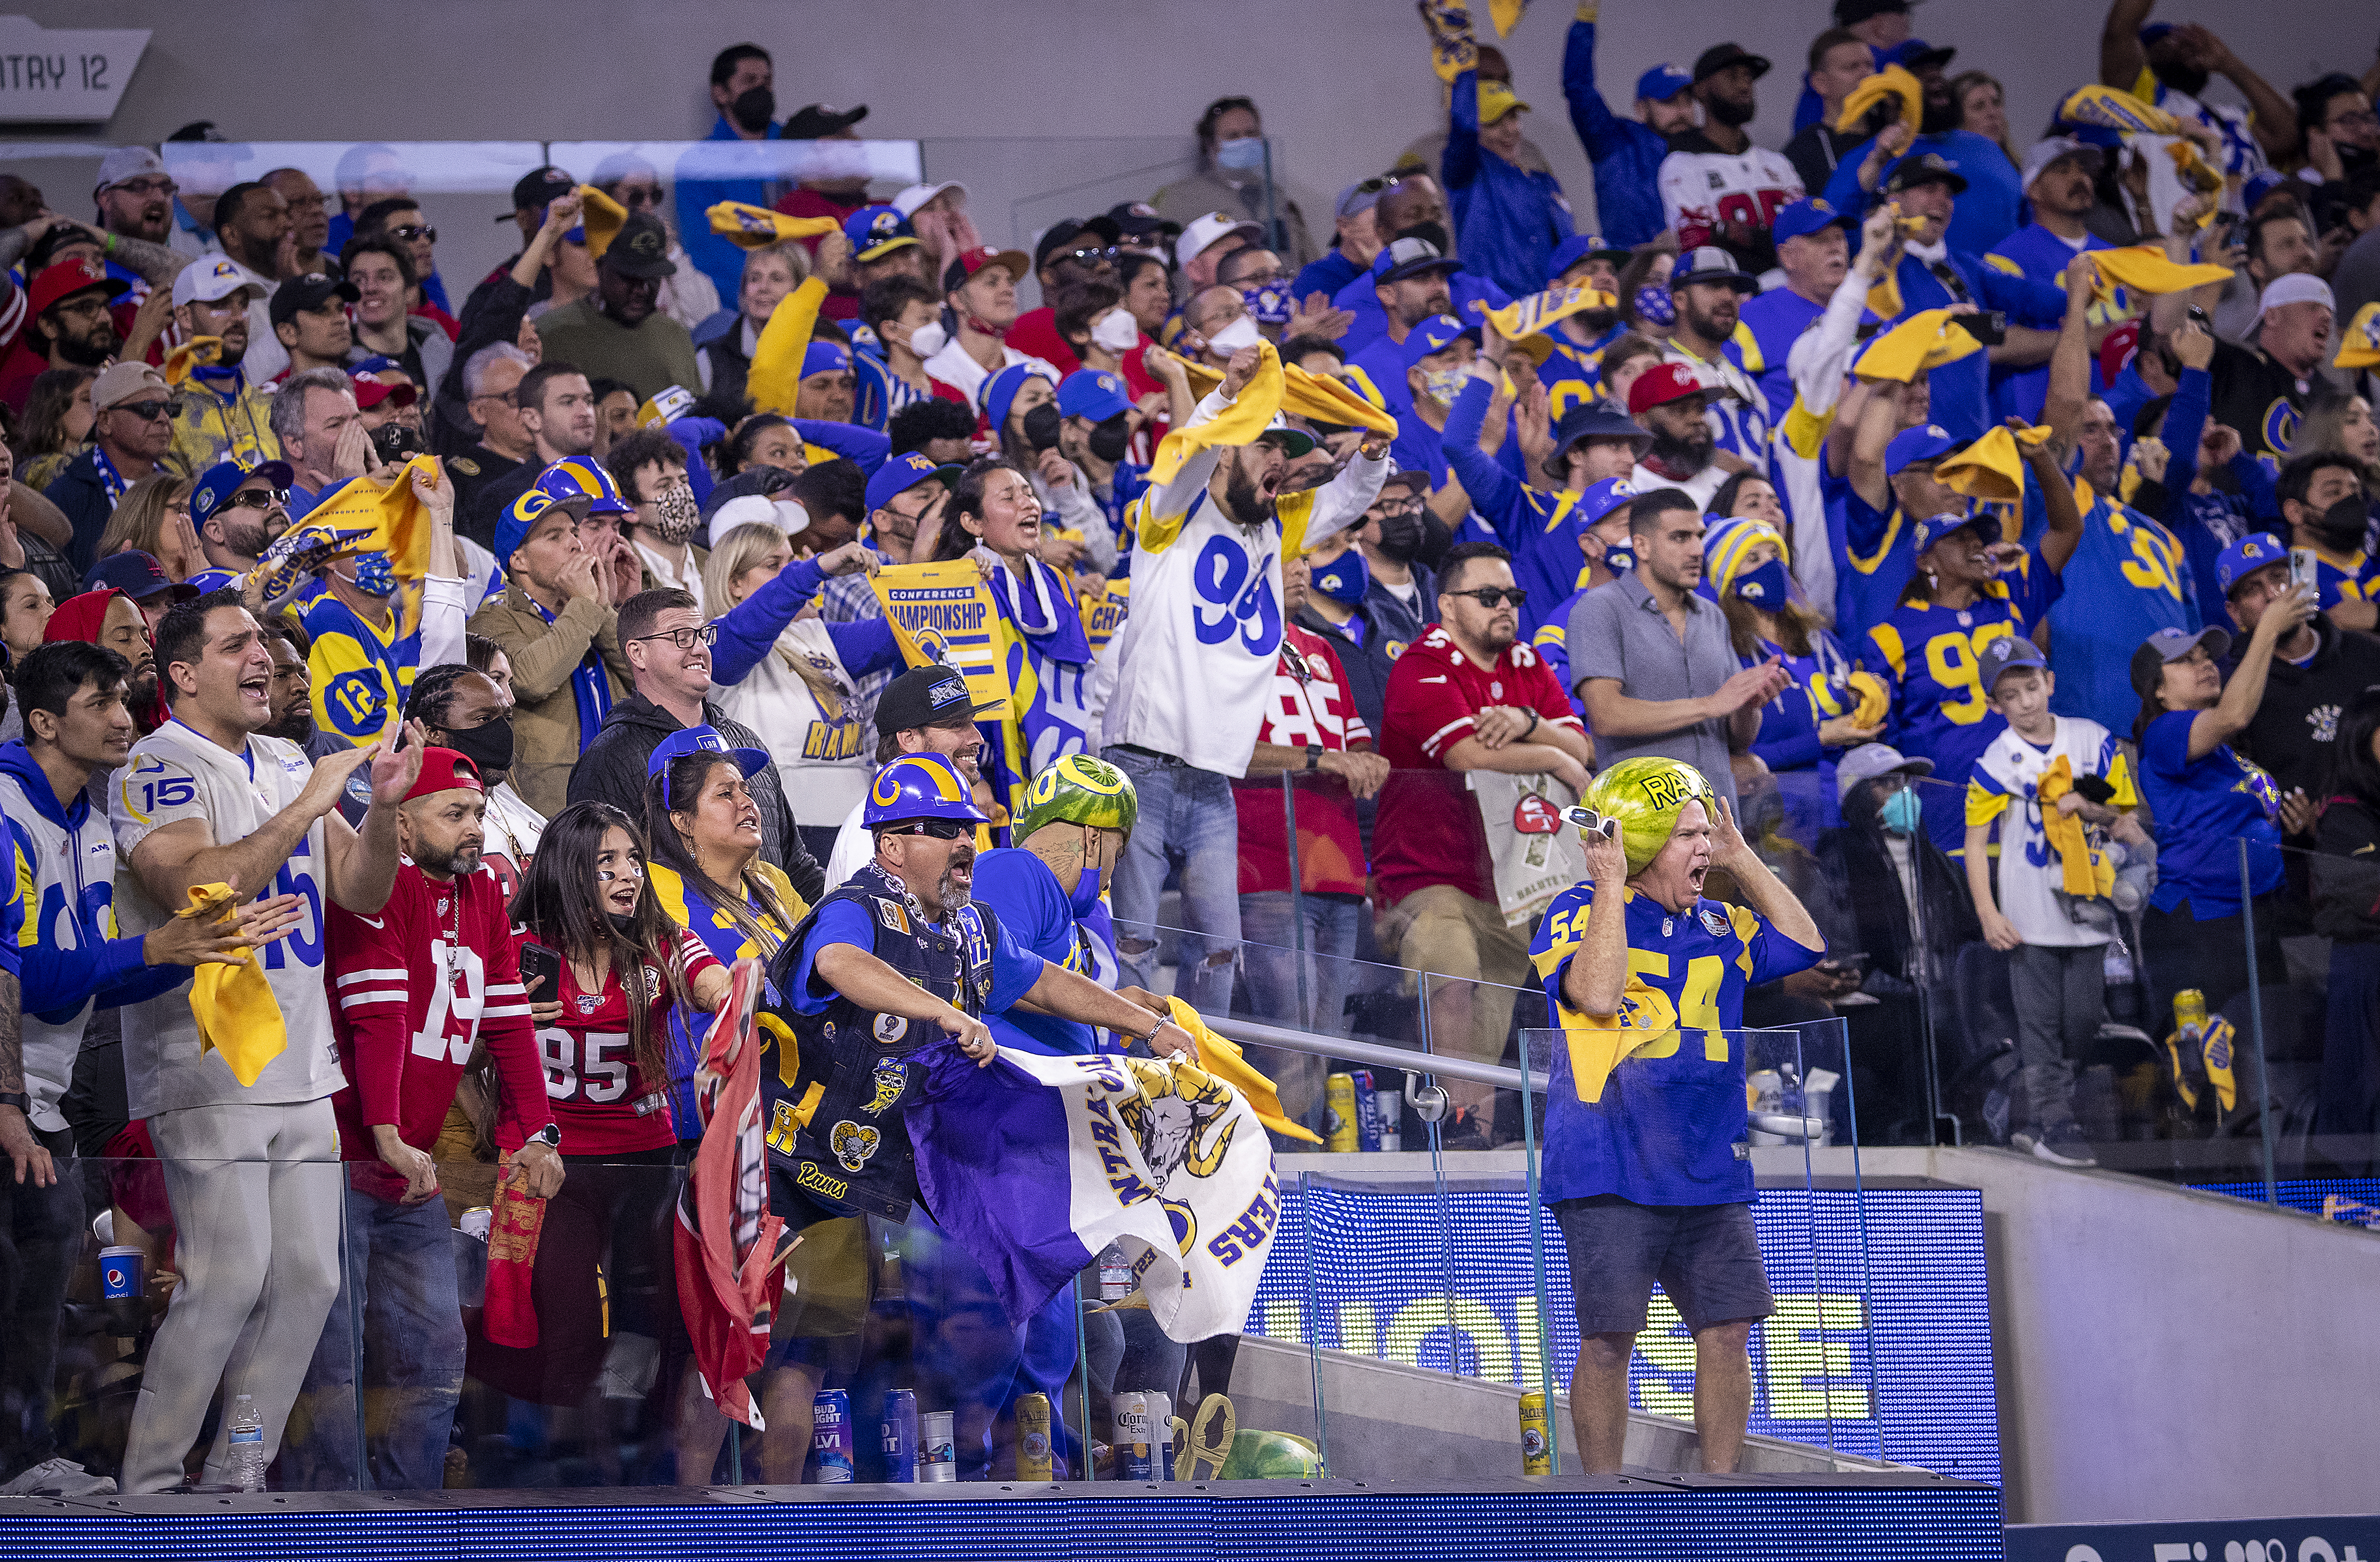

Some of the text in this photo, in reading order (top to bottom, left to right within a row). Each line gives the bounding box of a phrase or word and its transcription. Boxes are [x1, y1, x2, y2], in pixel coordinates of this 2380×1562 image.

[0, 54, 109, 91] TRY 12
[891, 588, 972, 600] CONFERENCE
[890, 602, 987, 631] HAMPIONSHIP
[334, 677, 376, 725] 12
[1266, 674, 1342, 751] 85
[703, 740, 718, 749] LAR
[142, 777, 196, 813] 15
[91, 843, 110, 854] AMS
[1550, 904, 1591, 948] 54
[412, 940, 485, 1065] 19
[1625, 948, 1728, 1062] 54
[878, 1032, 894, 1042] RAMS
[535, 1026, 630, 1103] 85
[1365, 1093, 1379, 1140] ULTRA
[796, 1161, 848, 1199] Rams
[814, 1404, 836, 1415] BUD
[1117, 1412, 1146, 1428] Coro
[815, 1434, 841, 1449] LVI
